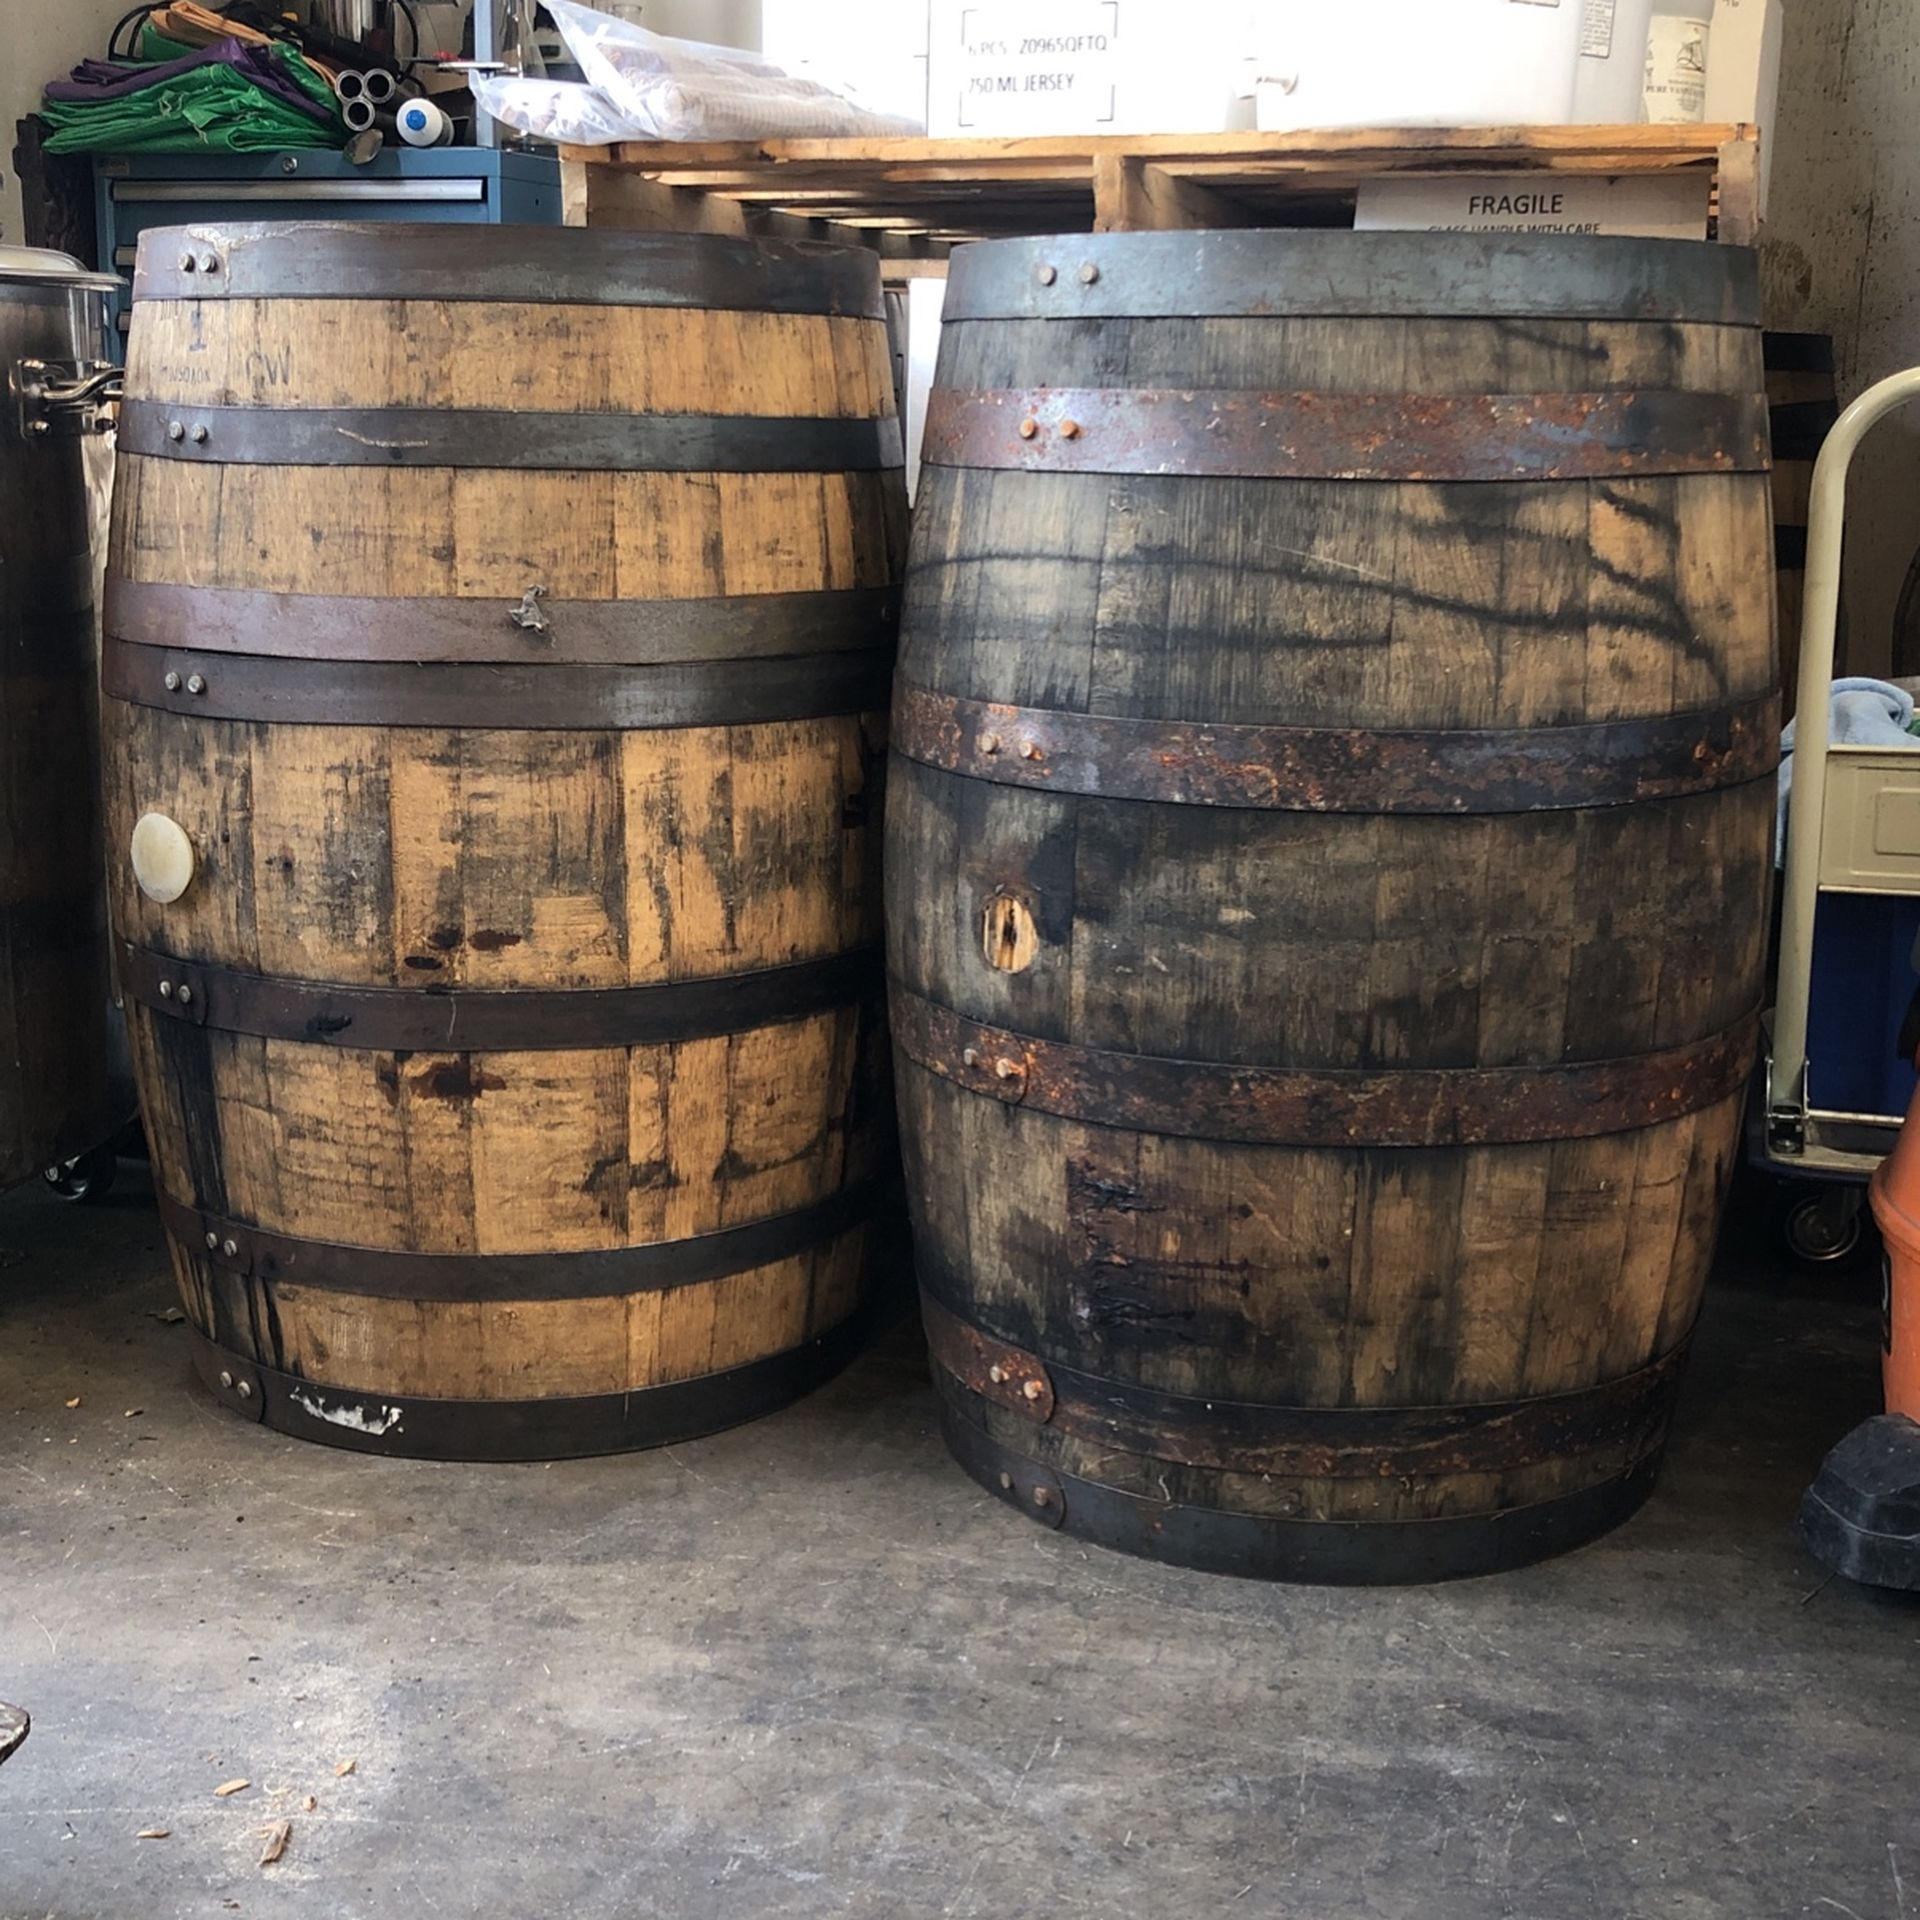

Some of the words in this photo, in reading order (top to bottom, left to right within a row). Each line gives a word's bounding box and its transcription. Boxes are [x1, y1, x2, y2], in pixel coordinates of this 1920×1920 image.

[980, 41, 1007, 56] PCS
[968, 77, 993, 94] 750
[997, 76, 1018, 92] ML
[1023, 73, 1075, 92] JERSEY
[1468, 193, 1564, 215] FRAGILE
[1528, 224, 1563, 234] WITH
[1567, 223, 1601, 235] CARE
